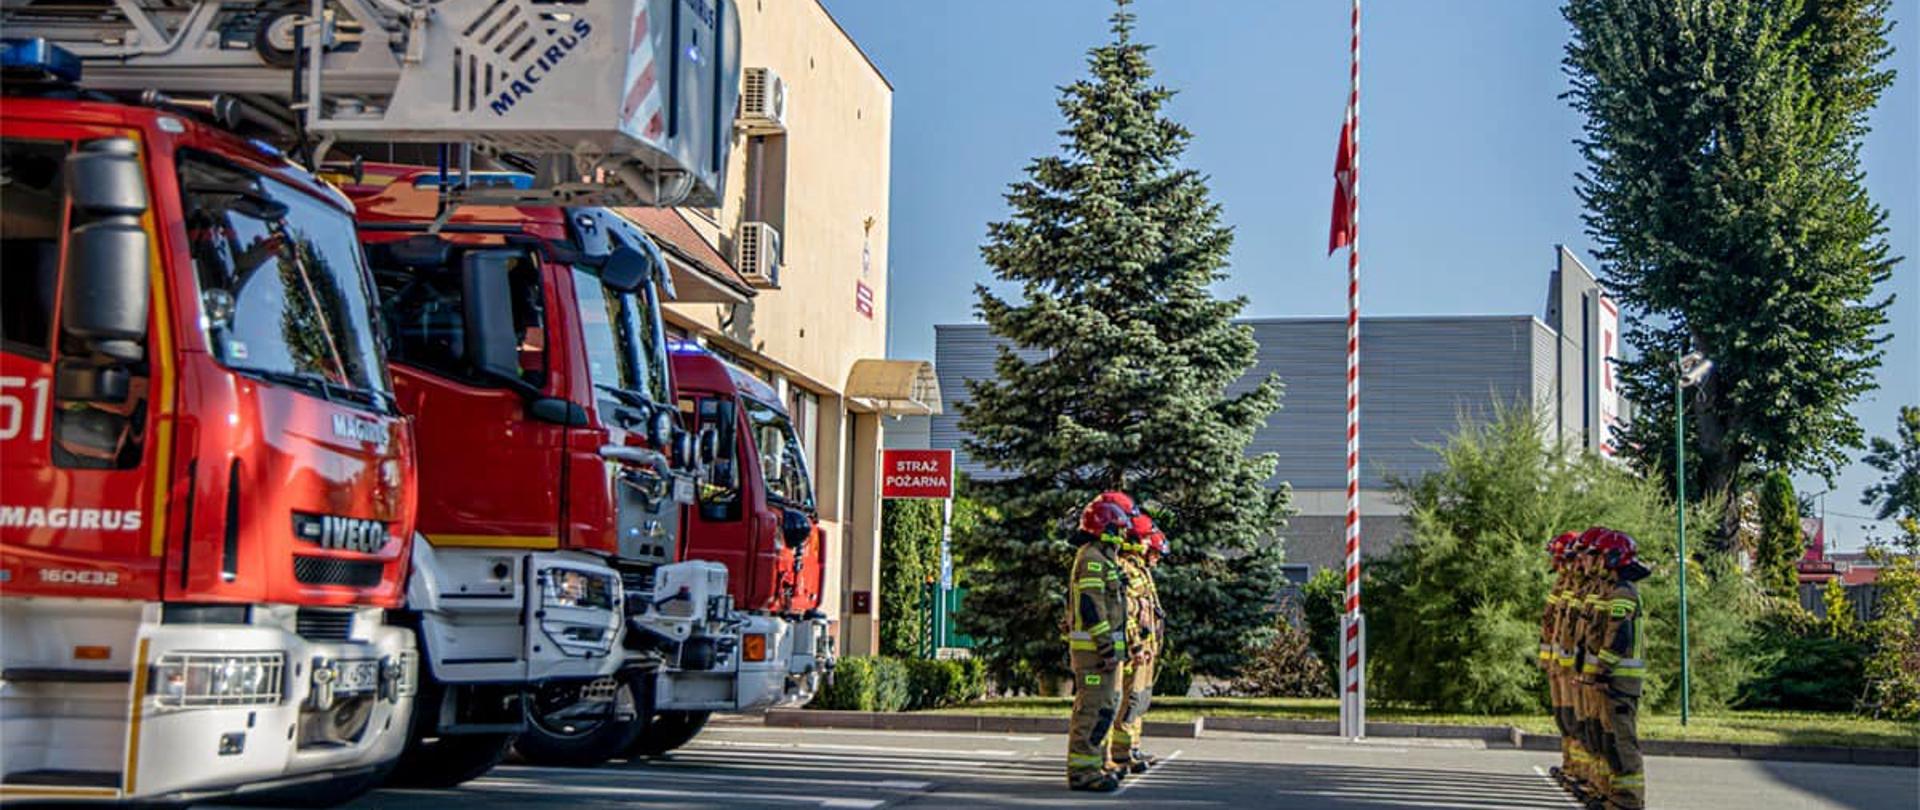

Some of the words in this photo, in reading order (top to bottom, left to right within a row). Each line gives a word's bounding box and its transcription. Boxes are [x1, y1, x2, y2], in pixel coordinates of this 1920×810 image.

[0, 376, 49, 442] 51
[896, 459, 938, 472] STRAŻ
[886, 475, 947, 487] POŻARNA
[0, 505, 142, 531] MAGIRUS
[323, 515, 383, 553] IVECO
